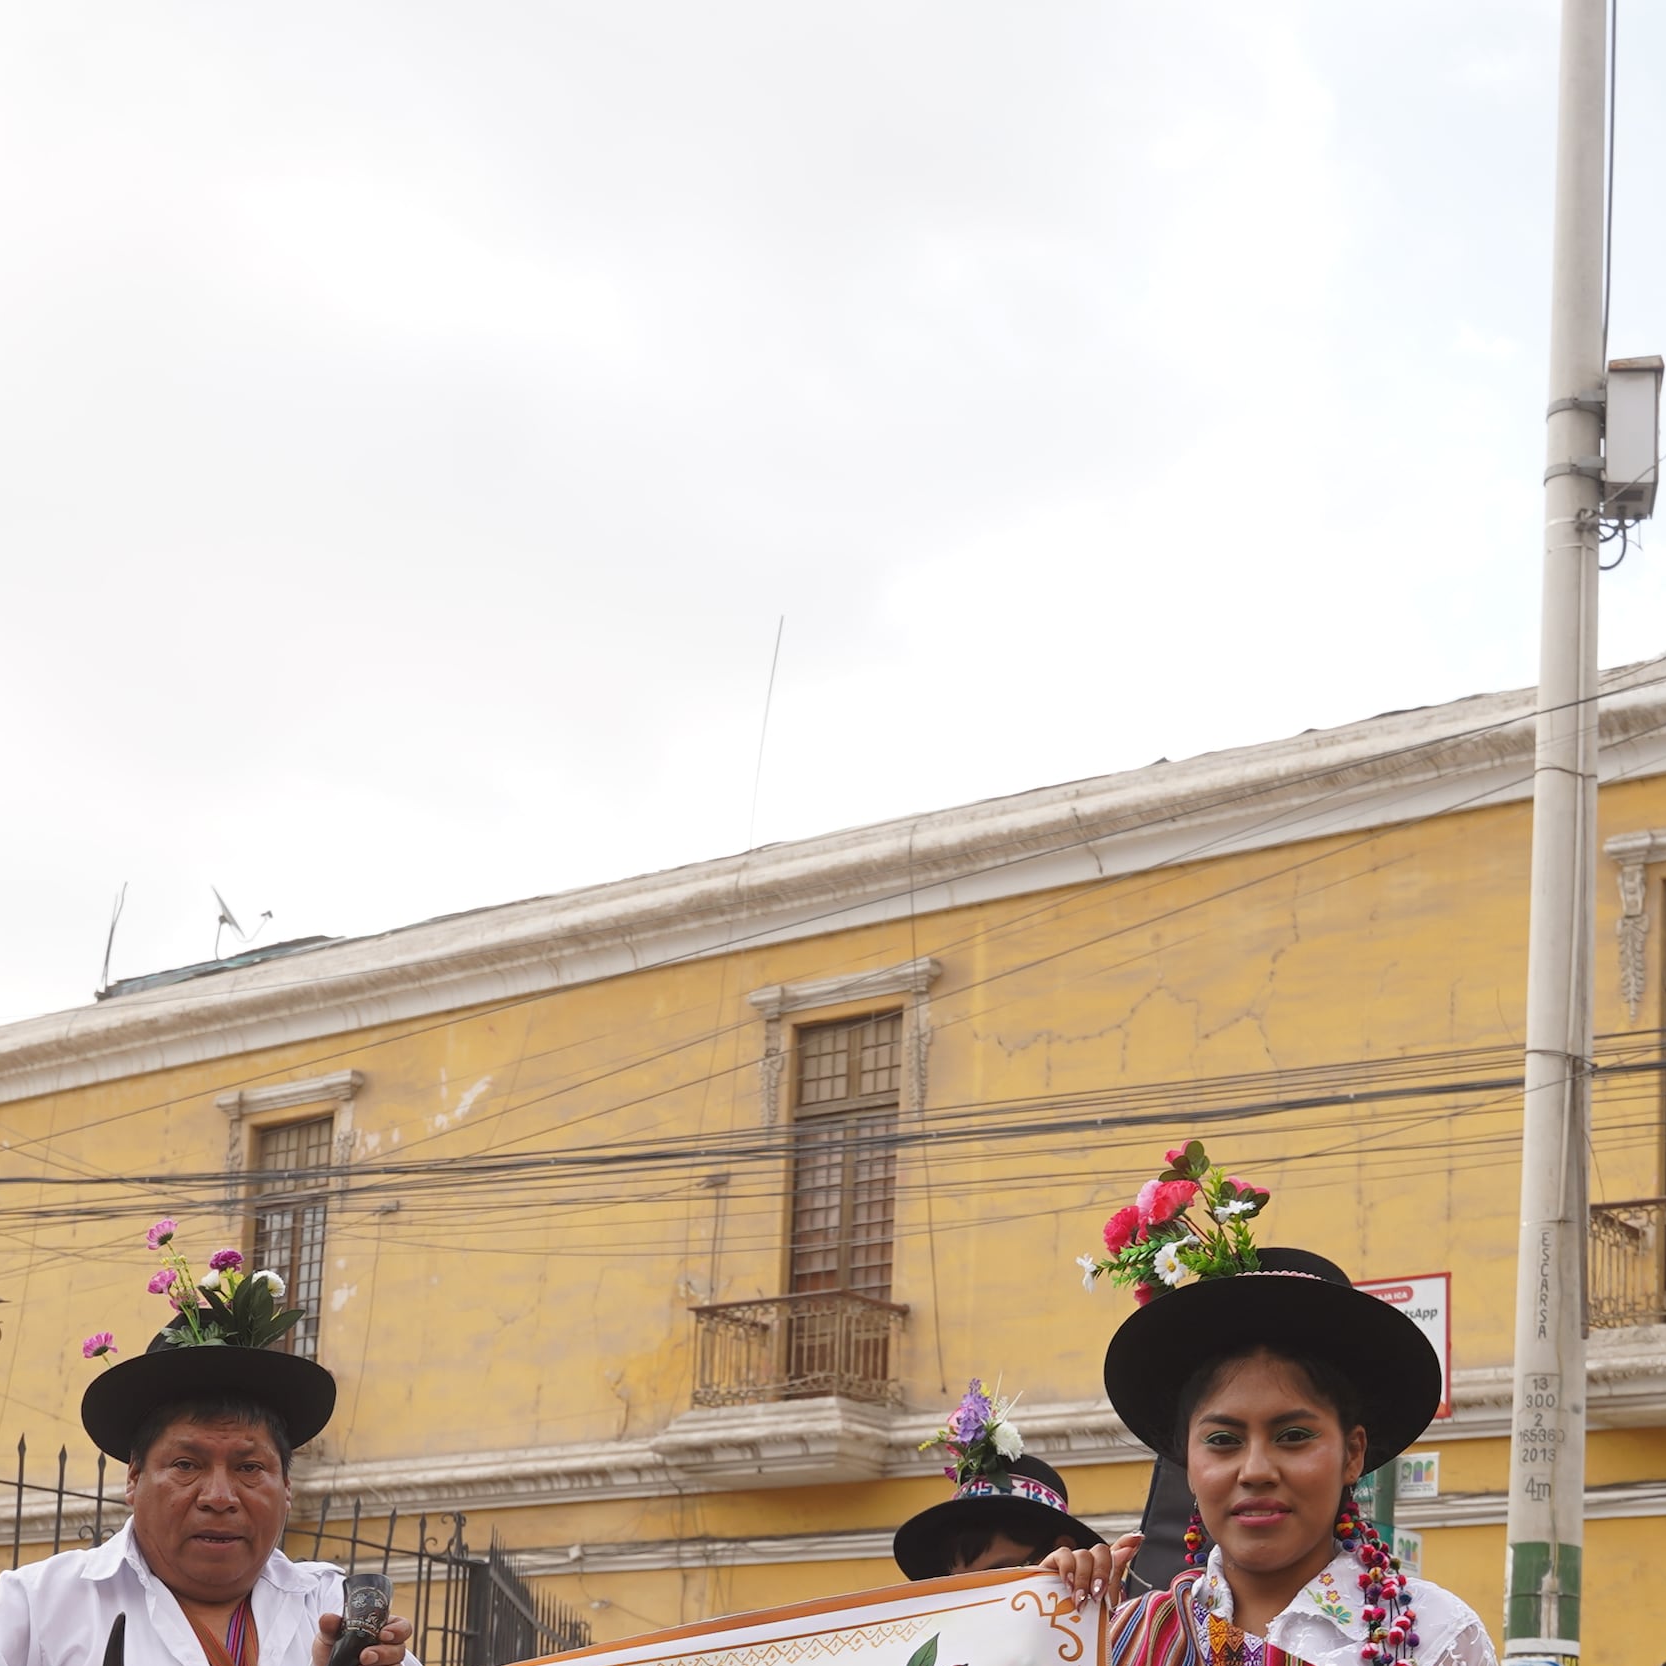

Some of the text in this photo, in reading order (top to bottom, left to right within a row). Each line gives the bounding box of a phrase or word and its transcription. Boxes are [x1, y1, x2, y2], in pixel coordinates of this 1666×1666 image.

[1537, 1231, 1550, 1340] ESCARSA
[1404, 1308, 1438, 1321] tsApp
[1532, 1376, 1549, 1391] 13
[1525, 1393, 1557, 1409] 300
[1534, 1413, 1544, 1427] 2
